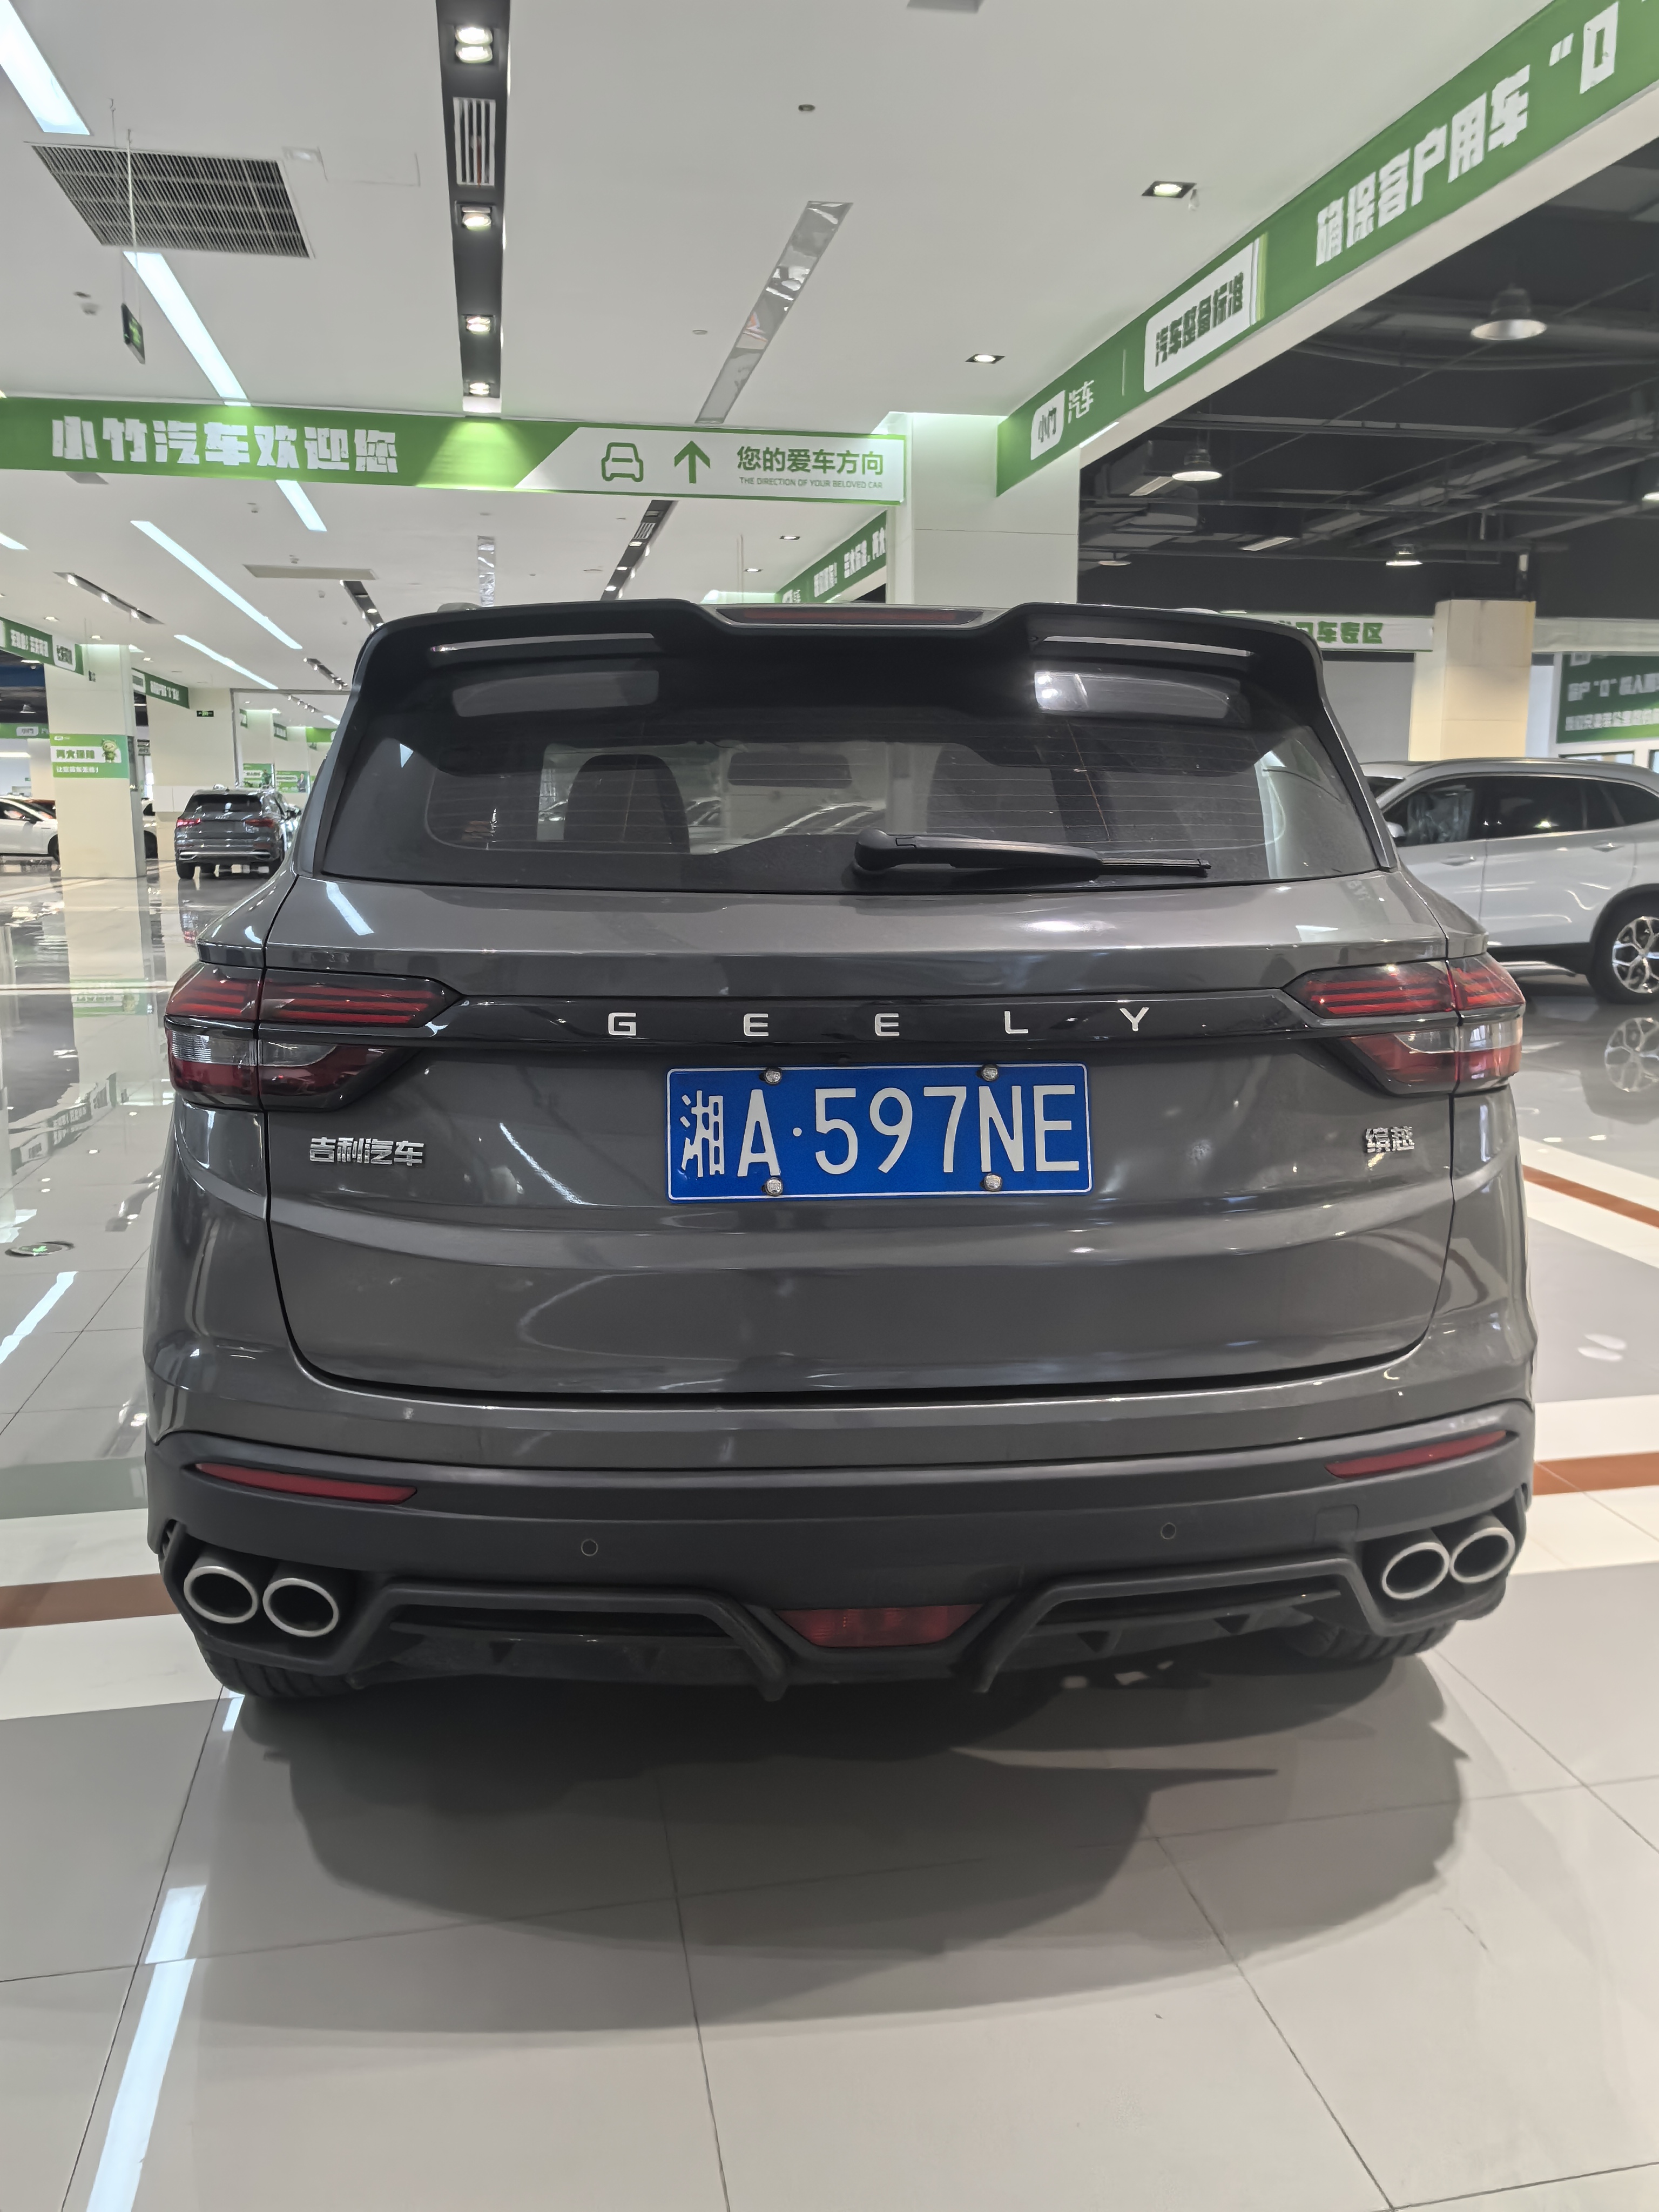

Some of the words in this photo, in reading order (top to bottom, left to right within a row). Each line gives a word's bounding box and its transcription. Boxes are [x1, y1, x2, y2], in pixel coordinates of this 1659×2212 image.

[1068, 380, 1095, 423] 汽车
[52, 415, 398, 473] 小竹汽车欢迎您
[737, 446, 884, 475] 您的爱车方向
[757, 477, 795, 486] DIRECTION
[832, 480, 866, 488] BELOVED
[608, 1007, 1149, 1037] GEELY
[309, 1137, 424, 1166] 吉利汽车
[1365, 1126, 1415, 1153] 缤越
